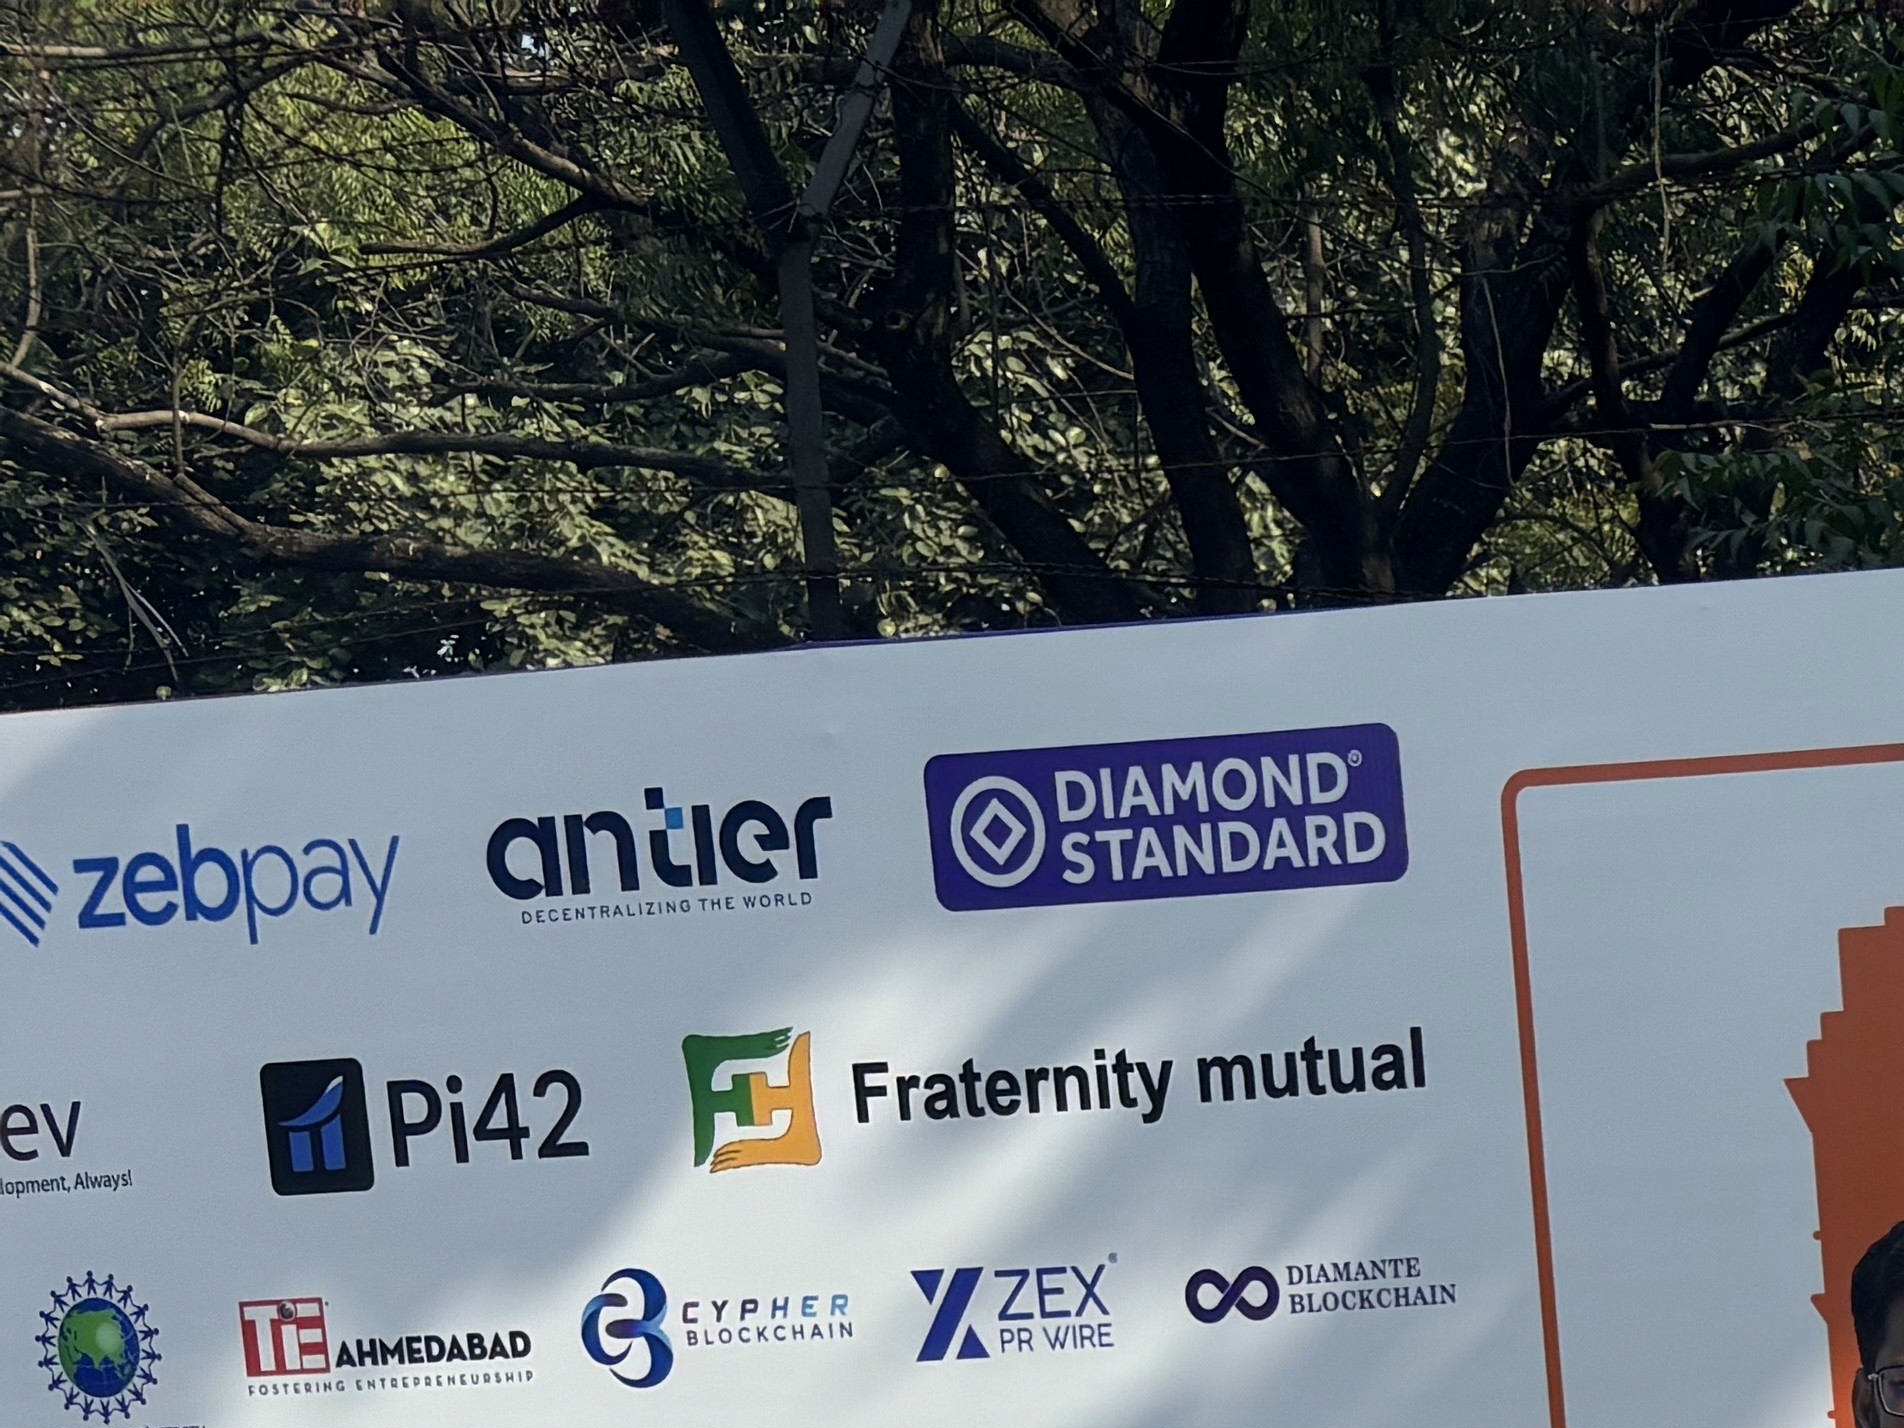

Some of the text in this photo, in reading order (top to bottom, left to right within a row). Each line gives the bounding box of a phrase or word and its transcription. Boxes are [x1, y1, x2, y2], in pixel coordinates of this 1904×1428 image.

[1054, 750, 1348, 824] DIAMOND
[486, 786, 832, 899] antier
[1061, 811, 1386, 885] STANDARD
[73, 824, 399, 944] zebpay
[521, 890, 813, 924] DECENTRALIZING THE WORLD
[852, 1026, 1426, 1123] Fraternity mutual
[386, 1070, 589, 1168] Pi42
[994, 1265, 1111, 1321] ZEX
[1287, 1256, 1421, 1285] DIAMANTE
[681, 1293, 849, 1325] CYPHER
[1289, 1283, 1457, 1315] BLOCKCHAIN
[335, 1330, 531, 1369] AHMEDABAD
[686, 1321, 853, 1347] BLOCKCHAIN
[1000, 1324, 1114, 1353] PR WIRE
